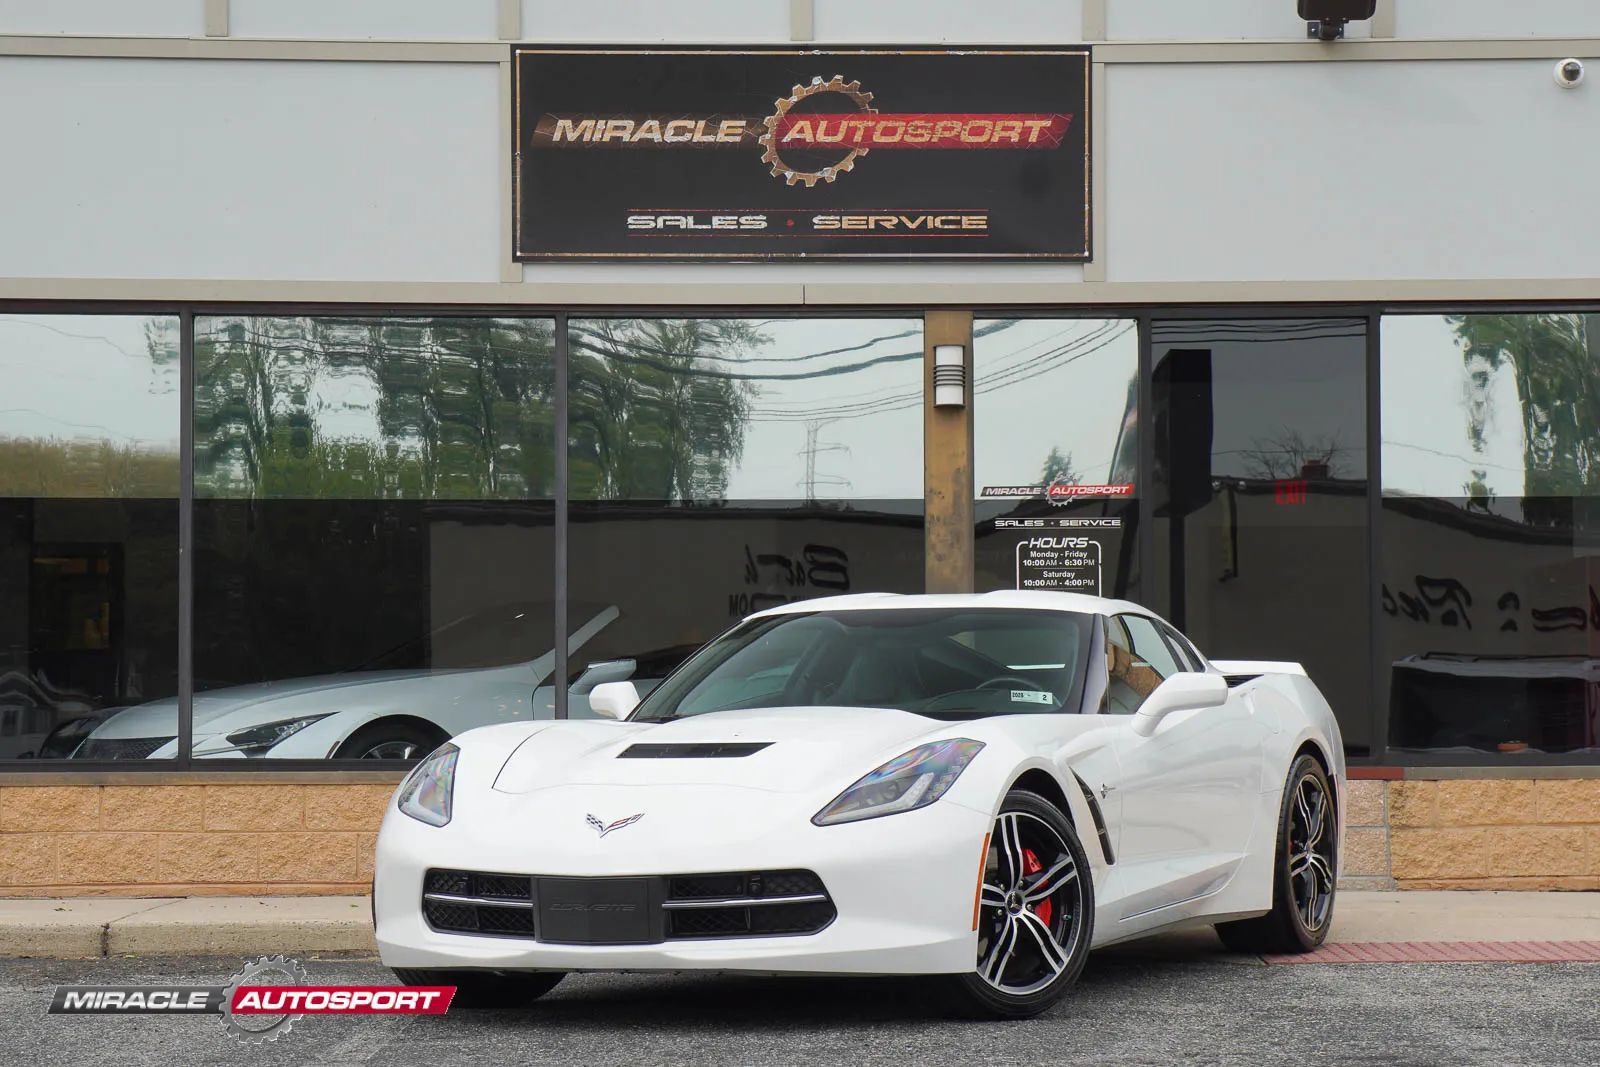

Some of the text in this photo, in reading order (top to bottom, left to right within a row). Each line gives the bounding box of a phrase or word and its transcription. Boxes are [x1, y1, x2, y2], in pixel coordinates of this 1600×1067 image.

[551, 119, 1052, 143] MIRACLE AUTOSPORT
[627, 214, 988, 230] SALES SERVICE
[985, 485, 1130, 496] MIRACLE AUTOSPORT
[1275, 479, 1308, 505] EXIT
[994, 519, 1121, 527] SALES SERVICE
[1029, 537, 1089, 549] HOURS
[1030, 551, 1058, 559] Monday
[1064, 550, 1088, 559] Friday
[1023, 559, 1045, 567] 10:00
[1043, 571, 1076, 579] Saturday
[1023, 579, 1045, 587] 10:00
